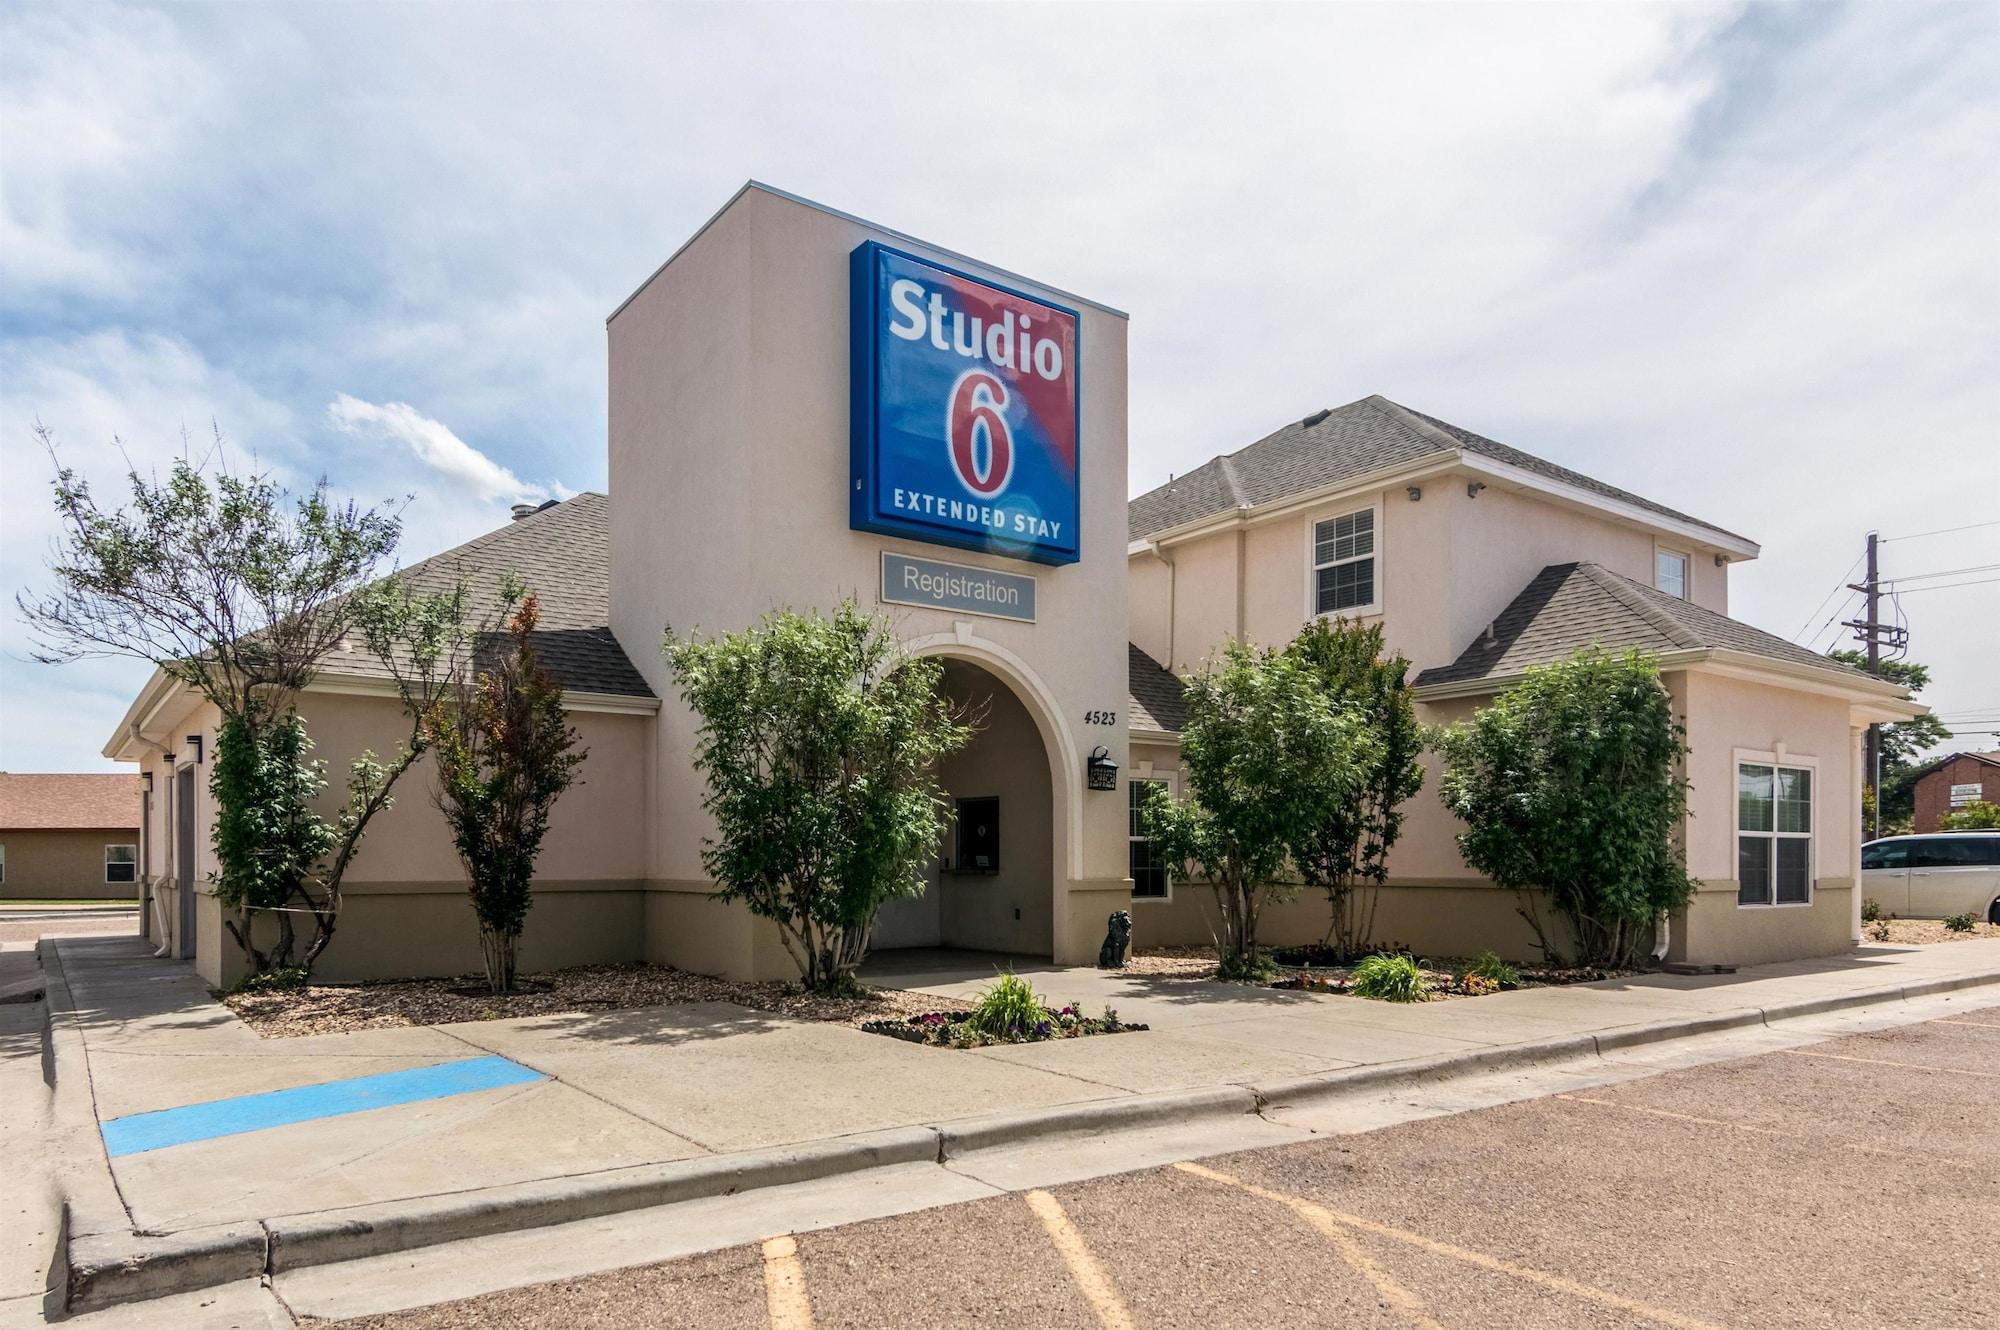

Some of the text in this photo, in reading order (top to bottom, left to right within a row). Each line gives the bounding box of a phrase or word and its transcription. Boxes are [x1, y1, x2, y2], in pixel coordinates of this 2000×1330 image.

[889, 279, 1063, 381] Studio
[946, 368, 1014, 499] 6
[893, 488, 1061, 540] EXTENDED STAY
[903, 565, 1019, 606] Registration
[1084, 711, 1116, 726] 4523
